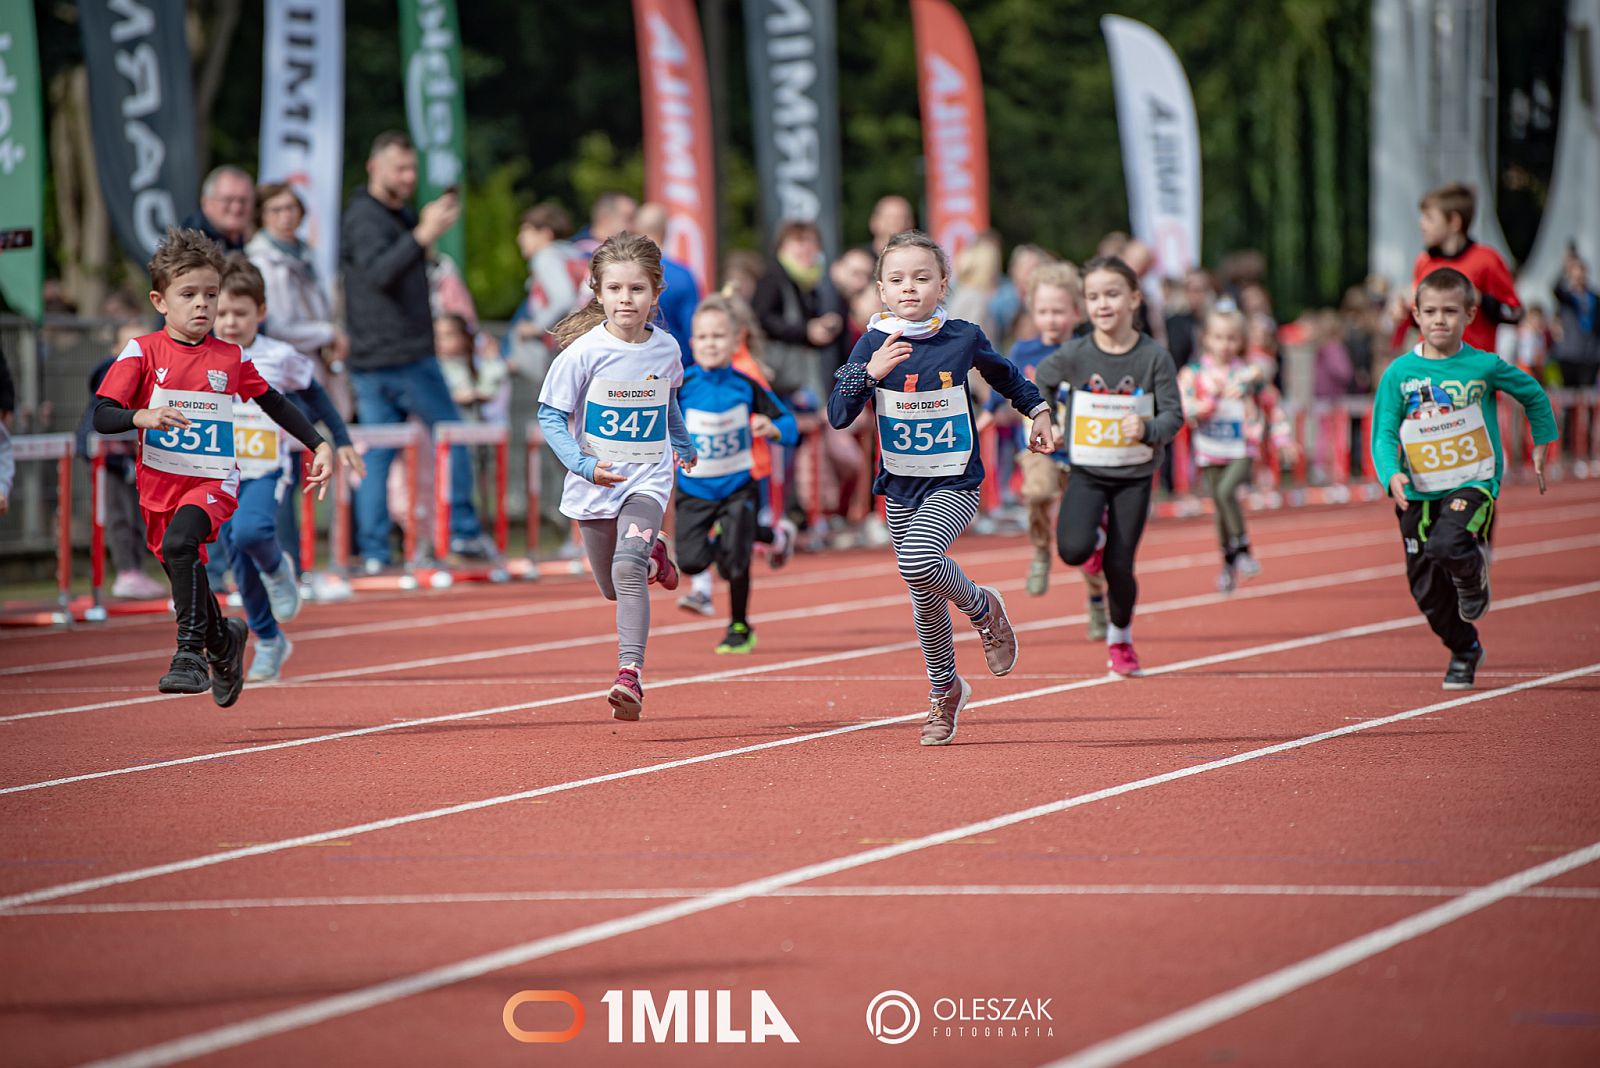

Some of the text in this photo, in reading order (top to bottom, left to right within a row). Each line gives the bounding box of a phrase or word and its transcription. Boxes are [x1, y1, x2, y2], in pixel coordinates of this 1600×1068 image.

[159, 422, 221, 453] 351
[598, 409, 659, 438] 347
[892, 420, 957, 451] 354
[1085, 419, 1132, 446] 34
[235, 430, 265, 457] 46
[694, 431, 741, 460] 355
[1420, 435, 1479, 470] 353
